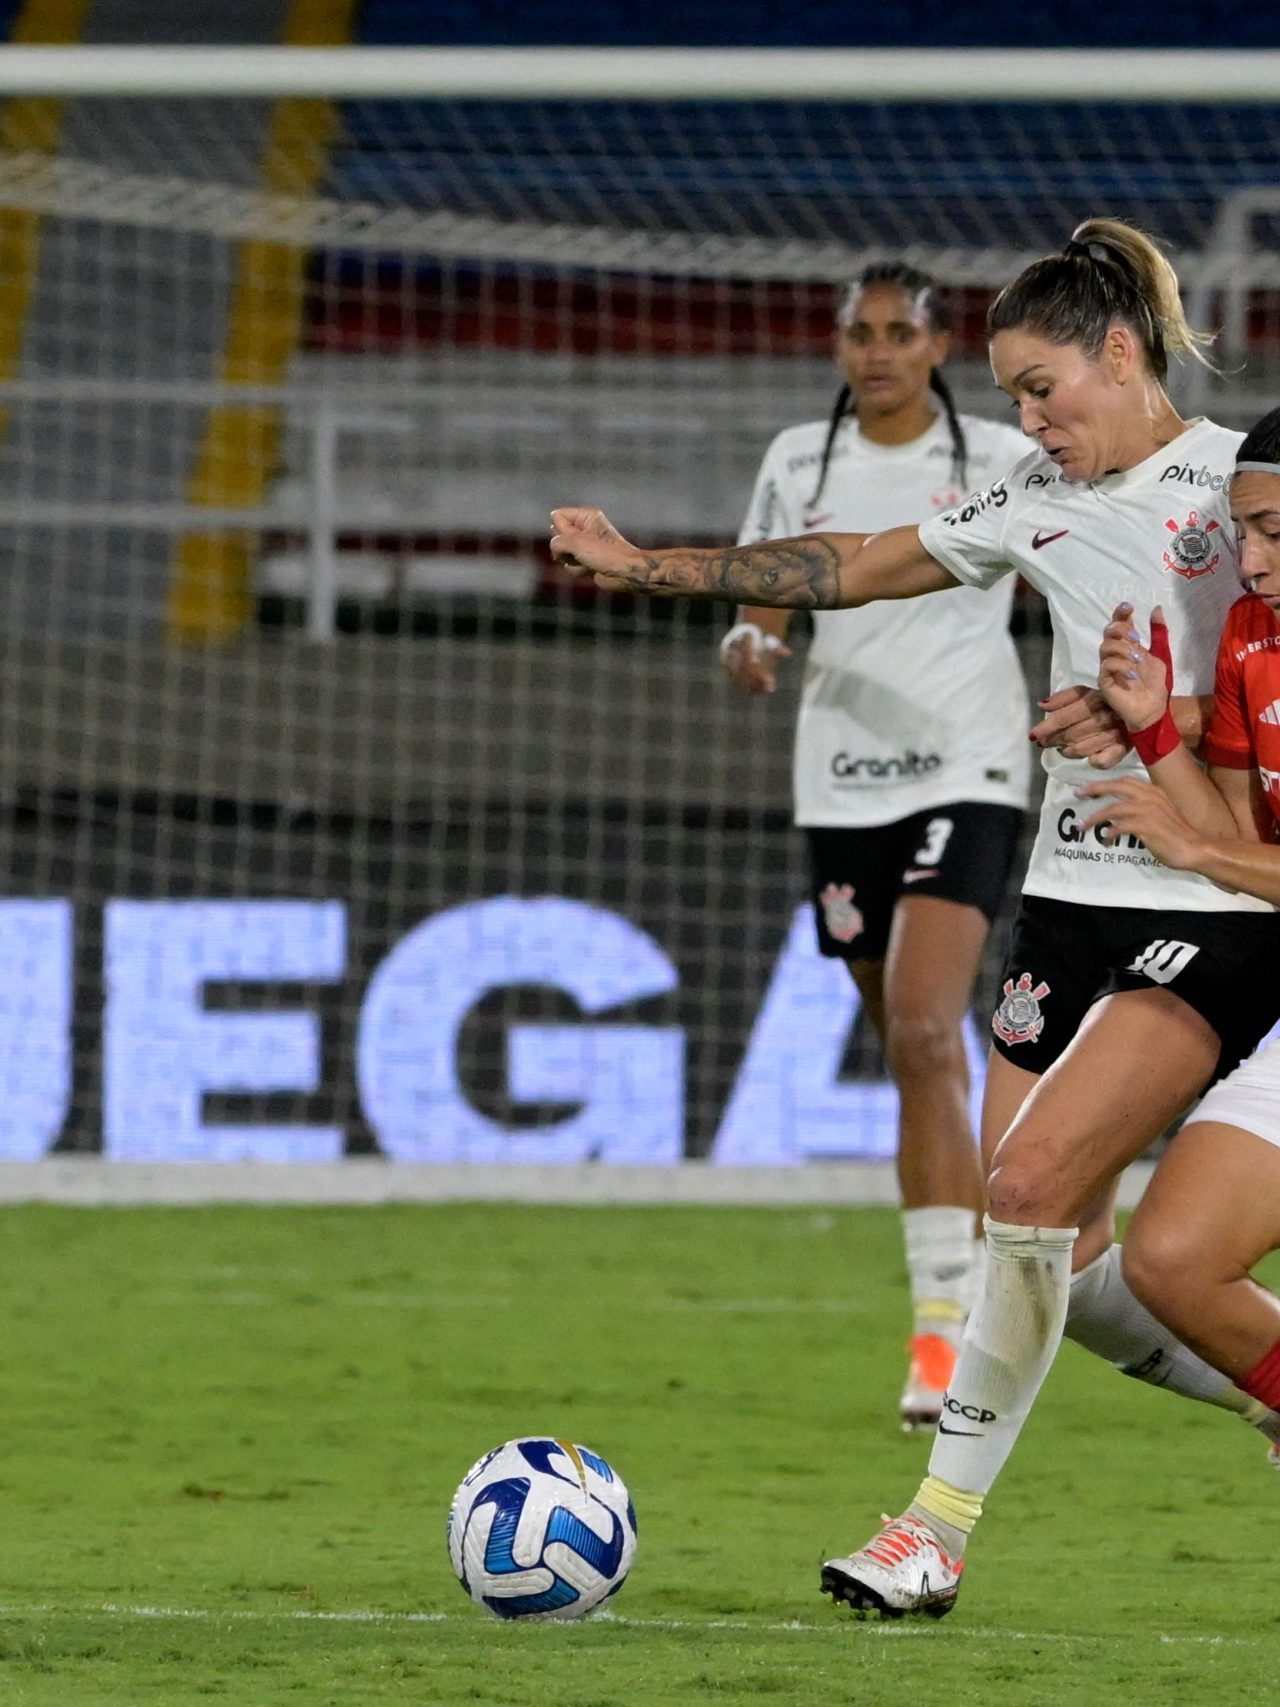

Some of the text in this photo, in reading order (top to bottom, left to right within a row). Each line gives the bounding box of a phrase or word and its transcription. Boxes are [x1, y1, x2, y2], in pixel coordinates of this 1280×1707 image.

[831, 750, 942, 778] Granito
[914, 818, 954, 866] 3
[1104, 853, 1115, 864] DE
[1124, 939, 1201, 985] 10
